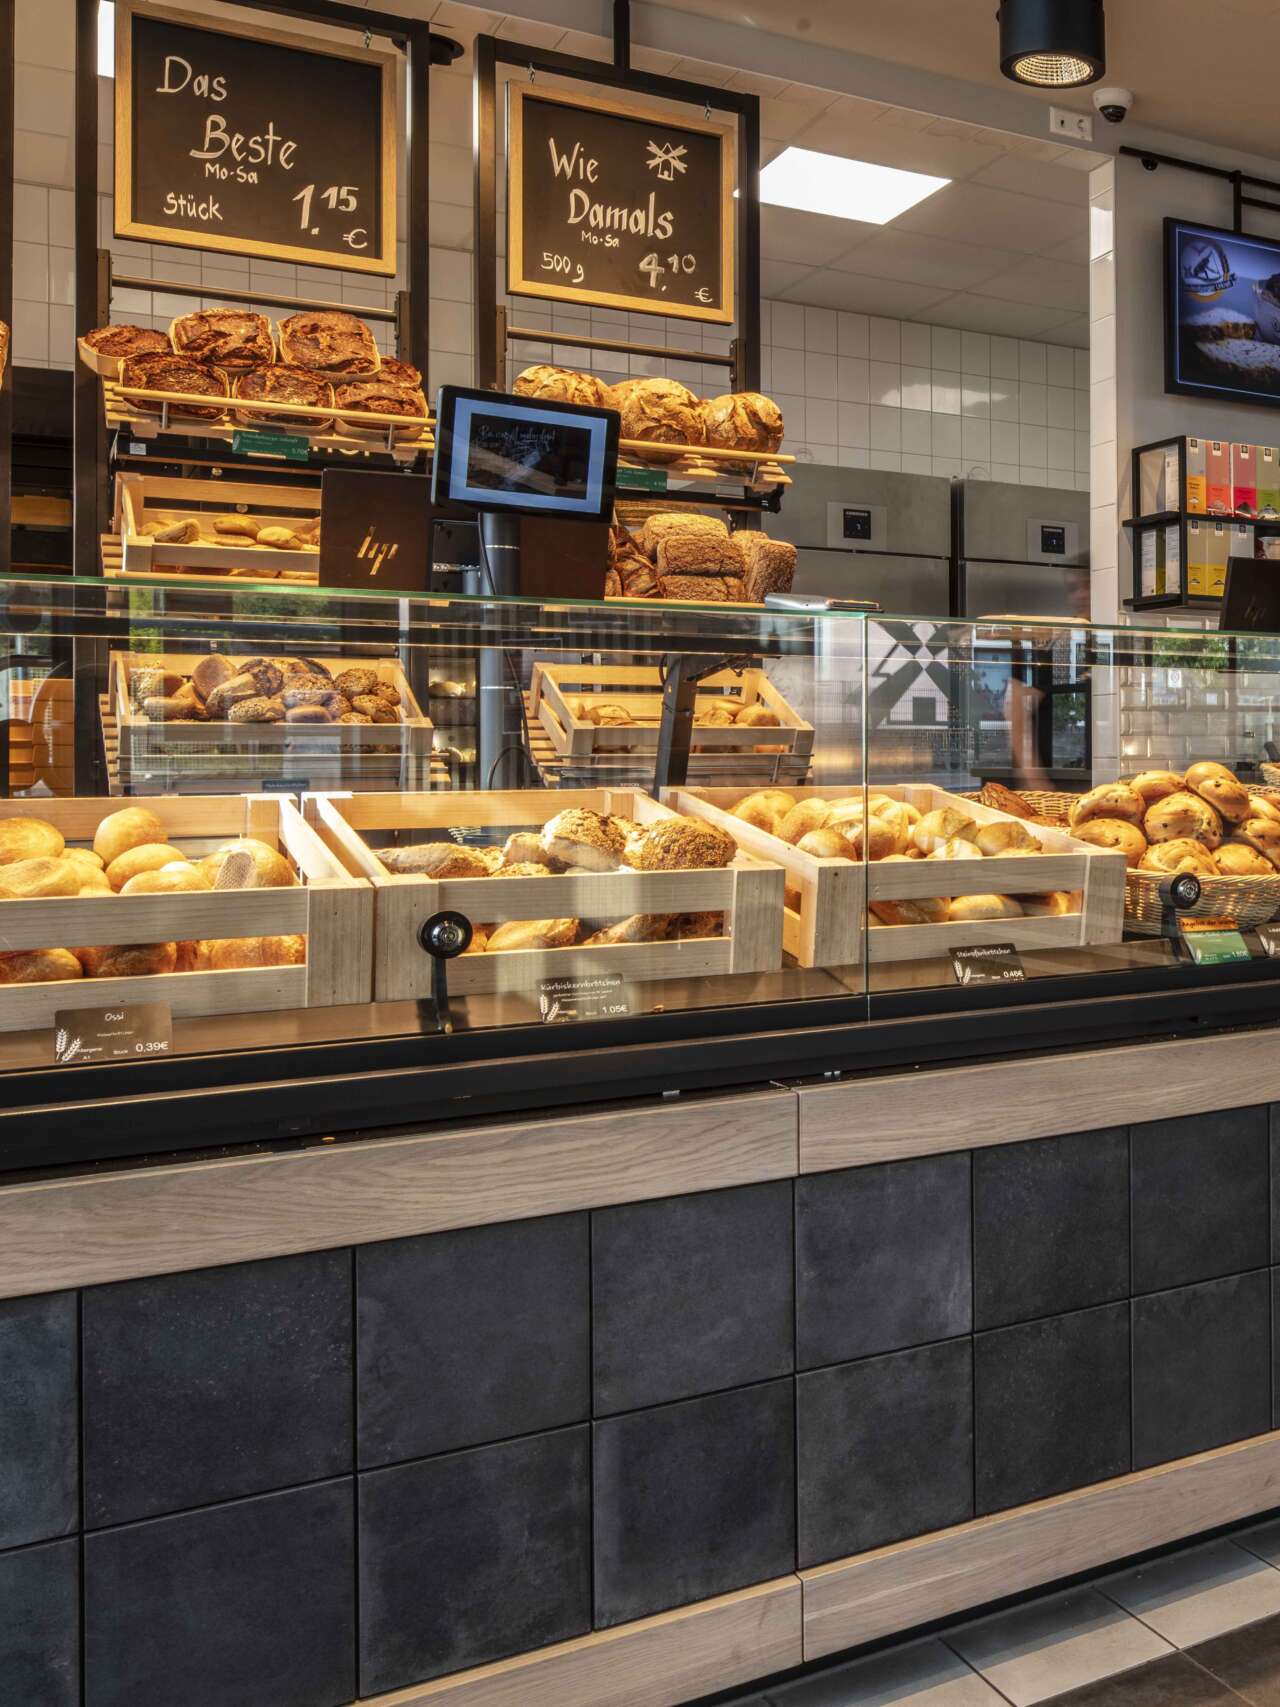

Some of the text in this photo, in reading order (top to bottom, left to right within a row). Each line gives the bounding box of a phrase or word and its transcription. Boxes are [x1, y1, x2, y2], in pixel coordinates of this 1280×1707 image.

[156, 55, 227, 101] Das
[189, 114, 297, 169] Beste
[549, 137, 599, 183] Wie
[163, 192, 223, 221] Stück
[567, 188, 675, 239] Damals
[105, 1012, 124, 1022] Ossi
